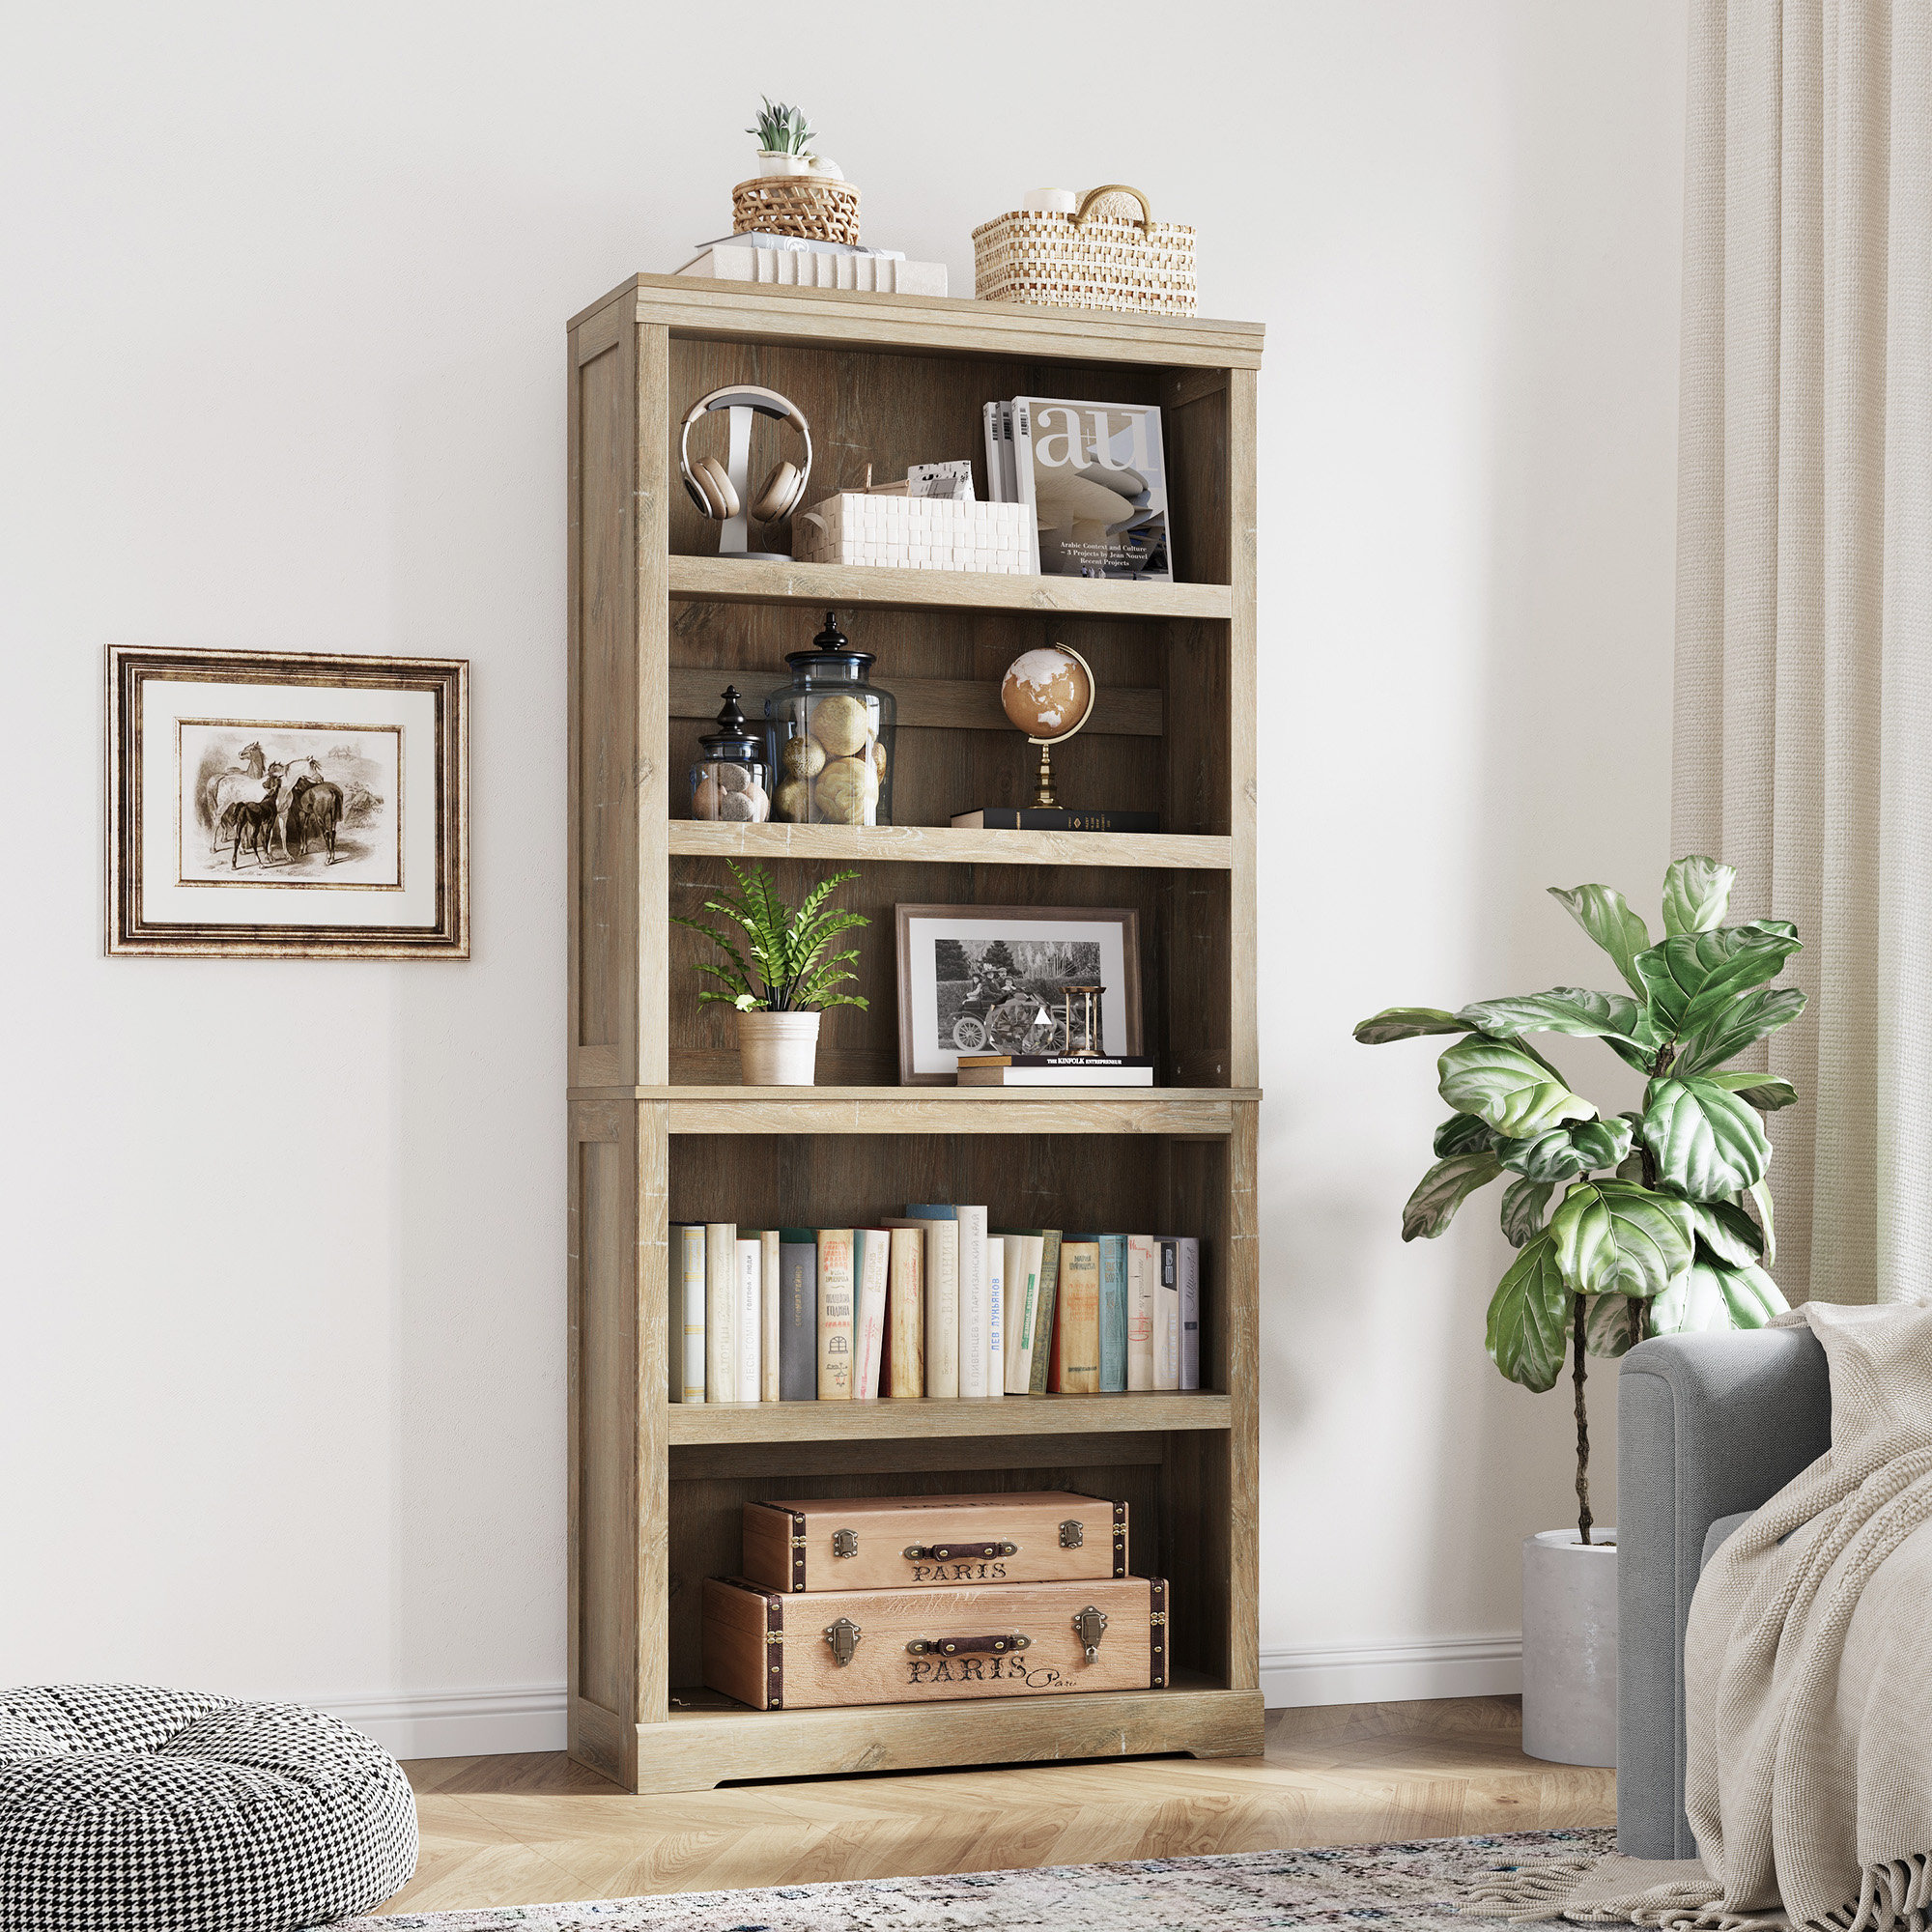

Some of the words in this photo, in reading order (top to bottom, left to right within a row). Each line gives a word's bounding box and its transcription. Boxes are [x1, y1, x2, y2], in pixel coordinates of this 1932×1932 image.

[1073, 550, 1099, 558] Projects
[1103, 558, 1130, 567] Projects
[971, 1213, 980, 1236] КРАЙ
[971, 1240, 980, 1313] ПАРТИЗАНСКИЙ
[991, 1277, 1000, 1328] ЛУКЬЯНОВ
[991, 1331, 1000, 1350] ЛЕВ
[745, 1354, 754, 1382] ЛЕСЬ
[912, 1562, 1007, 1582] PARIS
[907, 1655, 1028, 1684] PARIS
